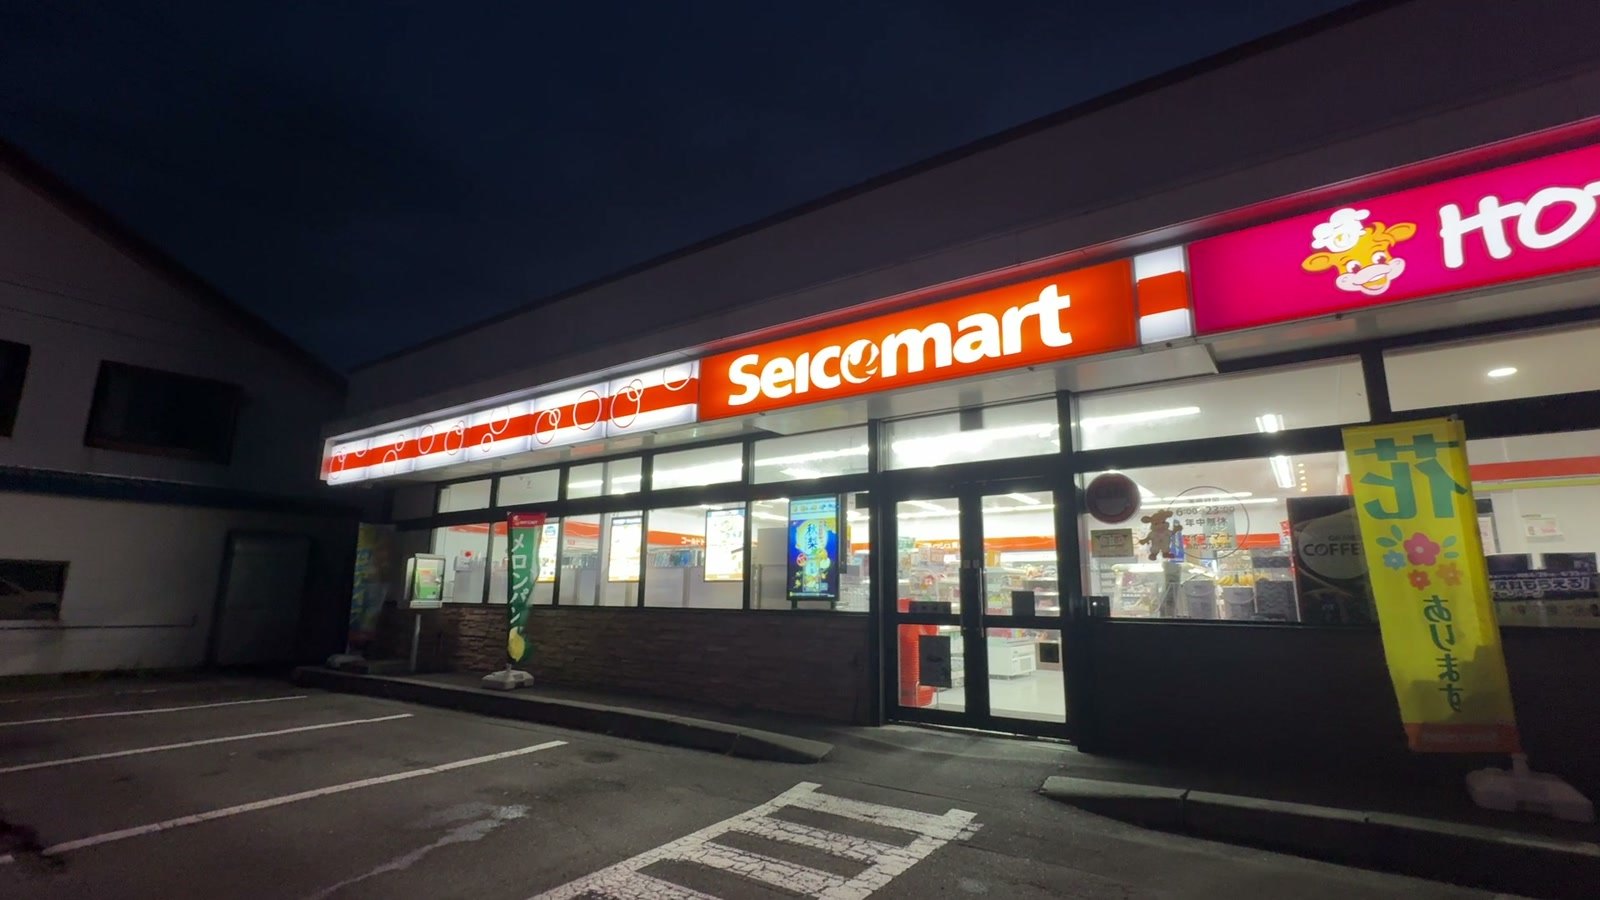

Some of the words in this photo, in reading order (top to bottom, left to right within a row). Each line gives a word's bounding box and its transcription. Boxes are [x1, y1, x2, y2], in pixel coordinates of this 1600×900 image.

[1439, 180, 1600, 268] HO
[728, 284, 1073, 406] Seicomart
[510, 533, 529, 624] メロンパン
